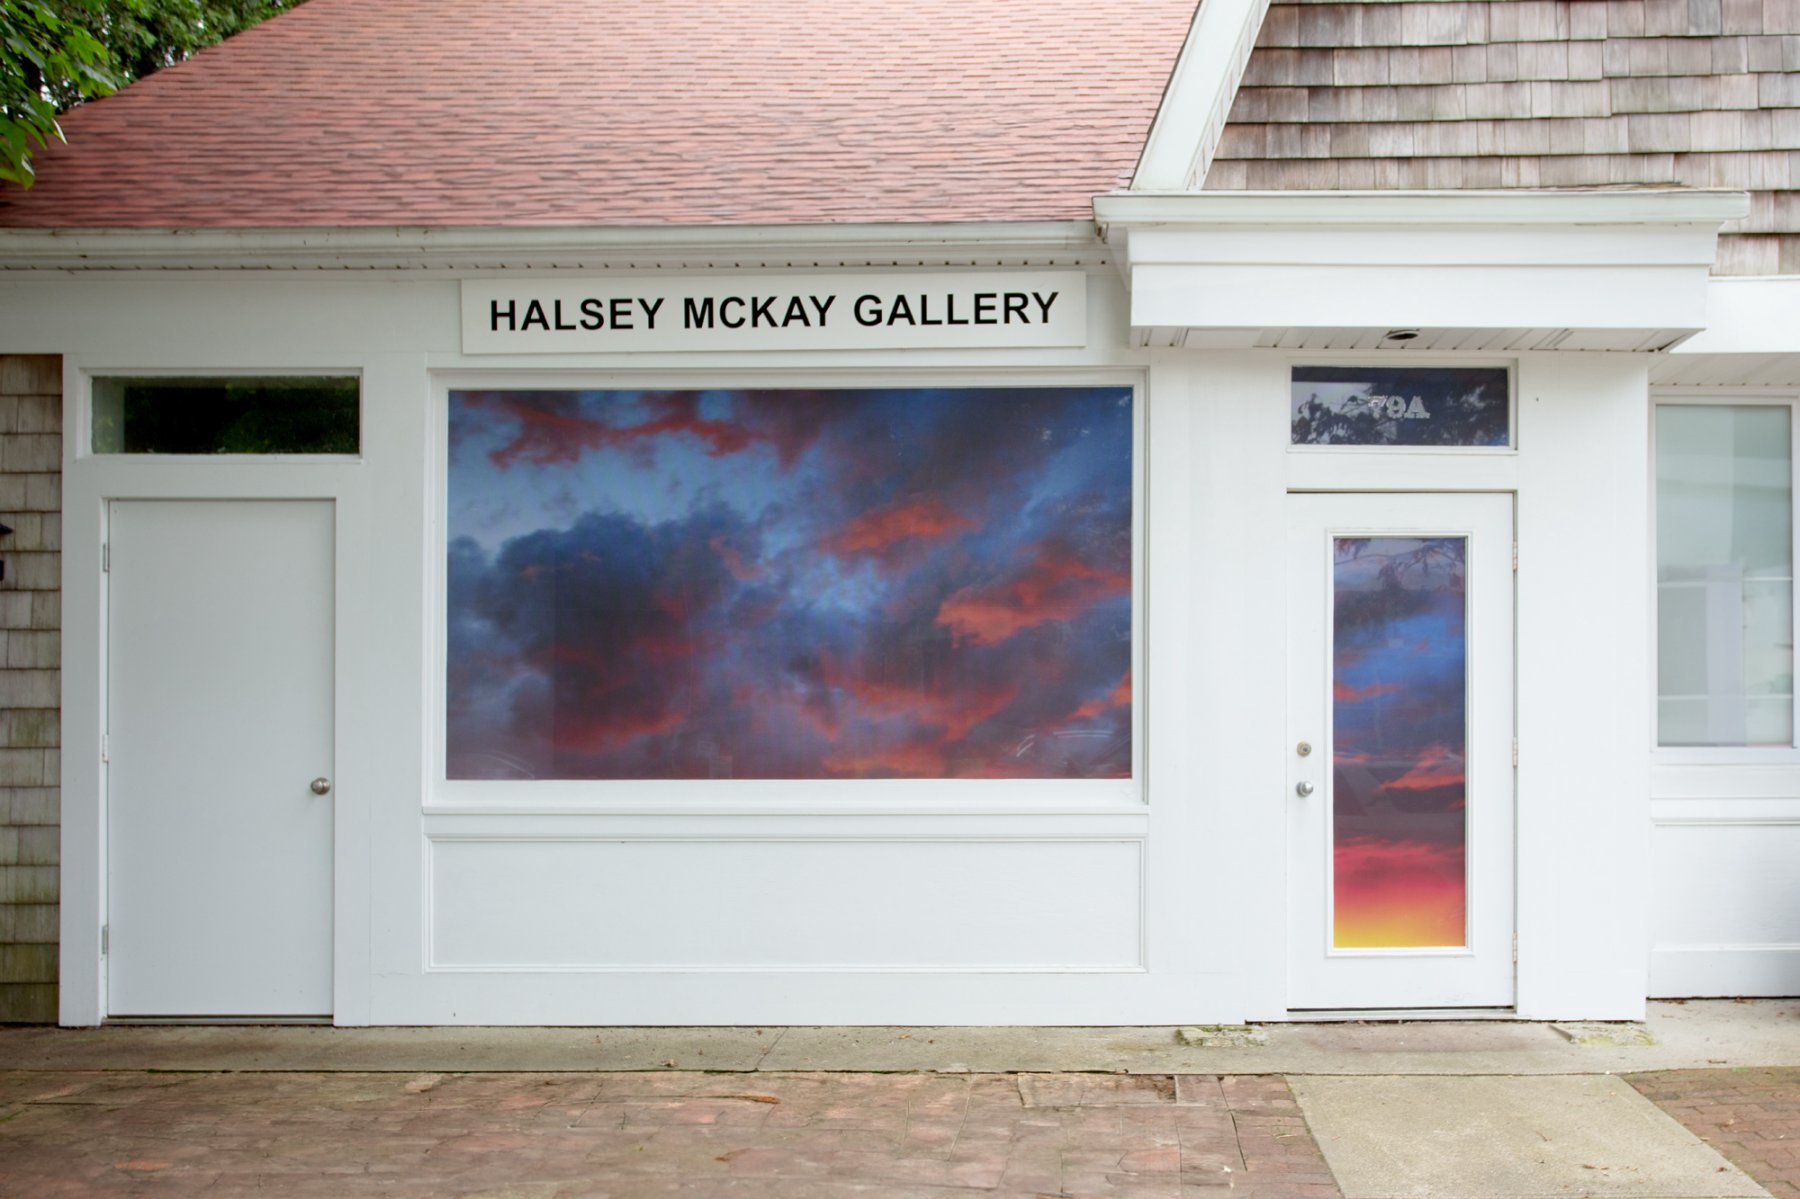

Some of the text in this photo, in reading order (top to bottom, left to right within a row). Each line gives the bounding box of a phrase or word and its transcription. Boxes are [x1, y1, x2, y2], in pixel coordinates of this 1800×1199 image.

[490, 291, 1059, 332] HALSEY MCKAY GALLERY
[1367, 395, 1431, 420] 79A
